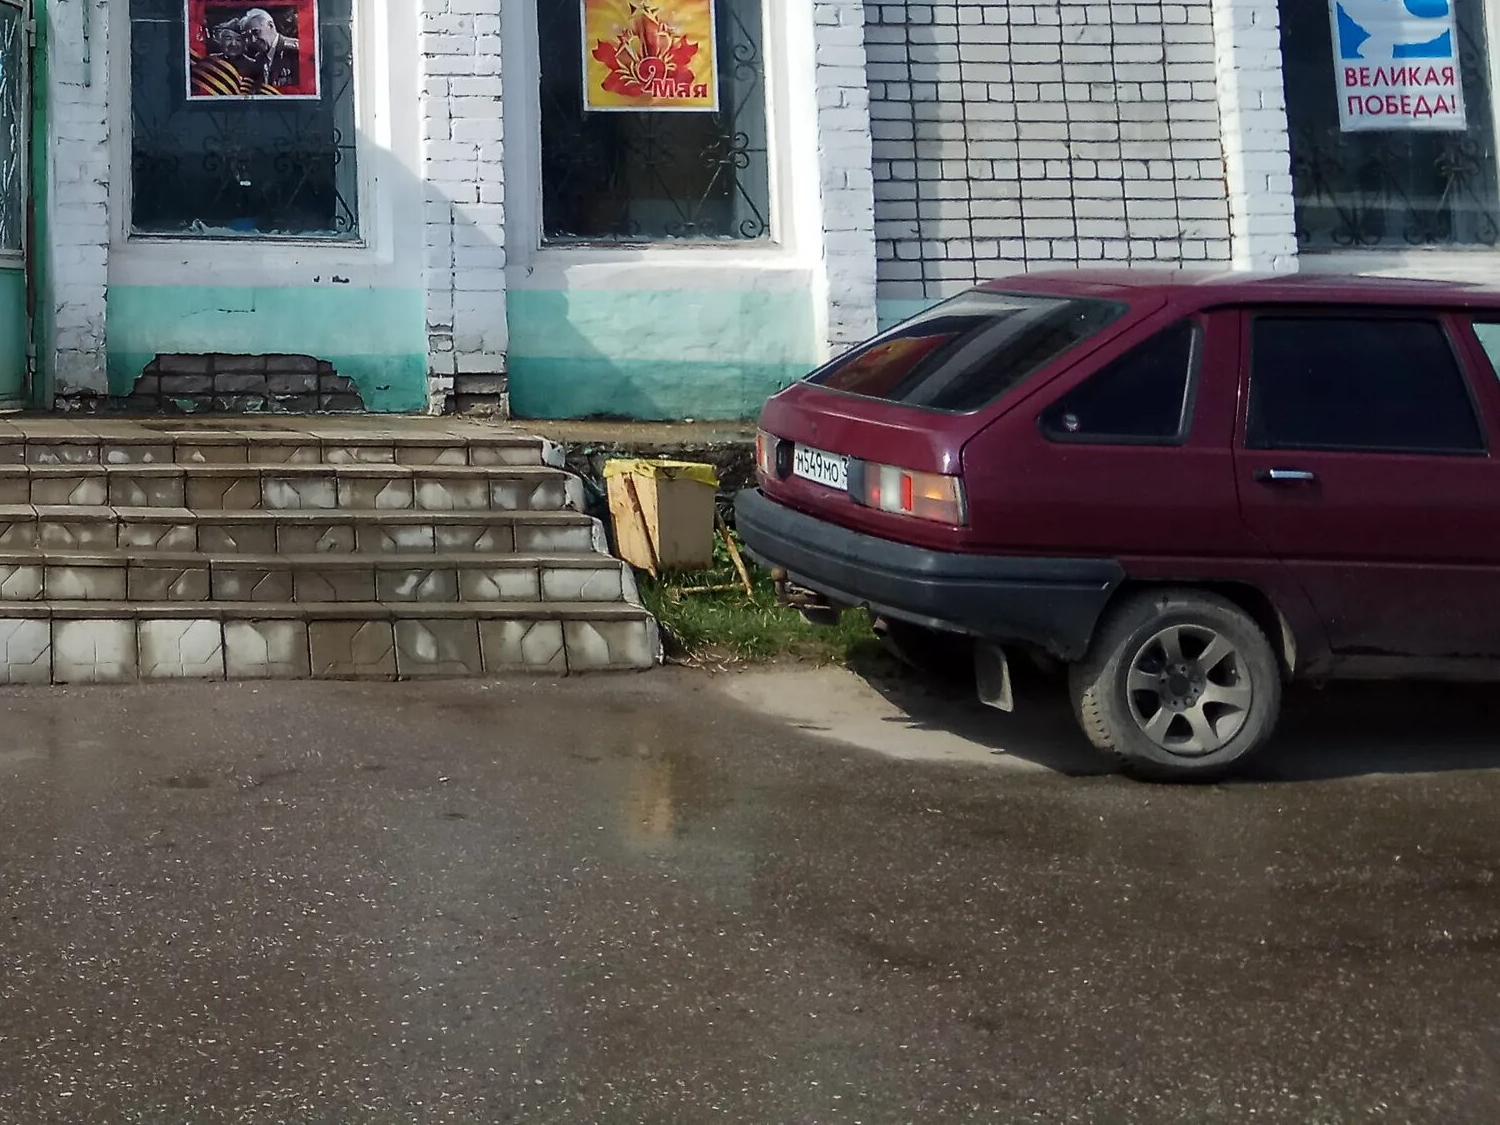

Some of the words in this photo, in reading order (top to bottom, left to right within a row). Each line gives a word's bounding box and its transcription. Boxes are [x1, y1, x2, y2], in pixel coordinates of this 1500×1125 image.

[637, 56, 667, 92] 9
[1344, 66, 1455, 87] ВЕЛИКАЯ
[651, 78, 708, 98] Мая
[1347, 94, 1457, 118] ПОБЕДА!
